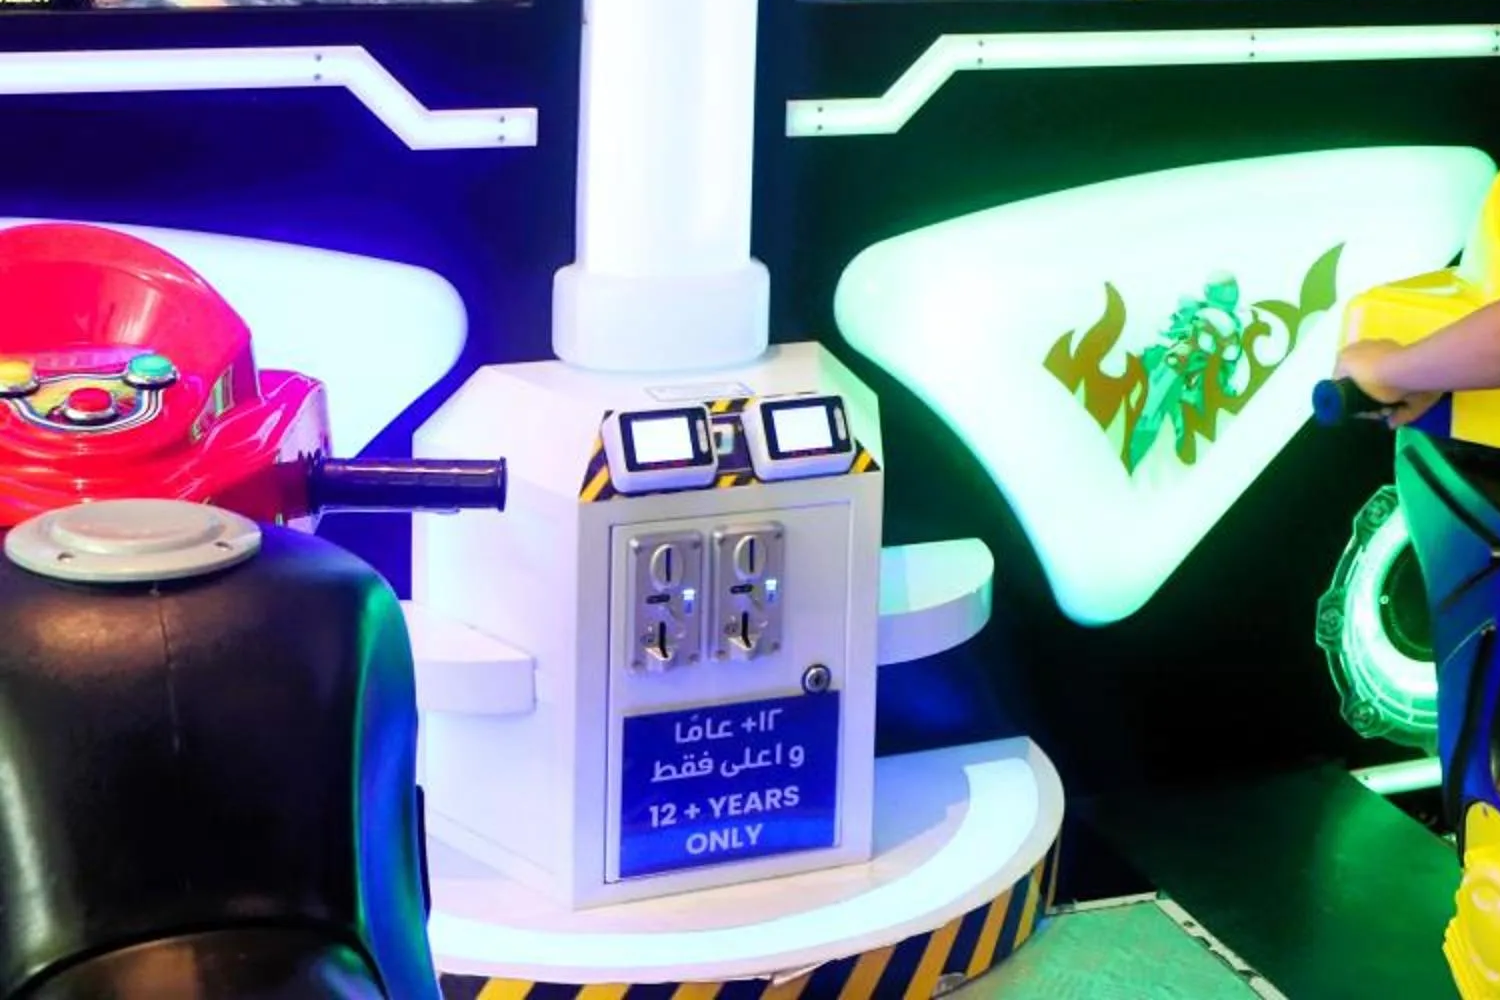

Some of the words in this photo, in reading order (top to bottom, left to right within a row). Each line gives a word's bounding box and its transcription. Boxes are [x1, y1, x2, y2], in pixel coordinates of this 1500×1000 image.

[650, 750, 714, 783] فقط
[649, 802, 677, 829] 12
[708, 784, 800, 820] YEARS
[685, 822, 764, 856] ONLY
